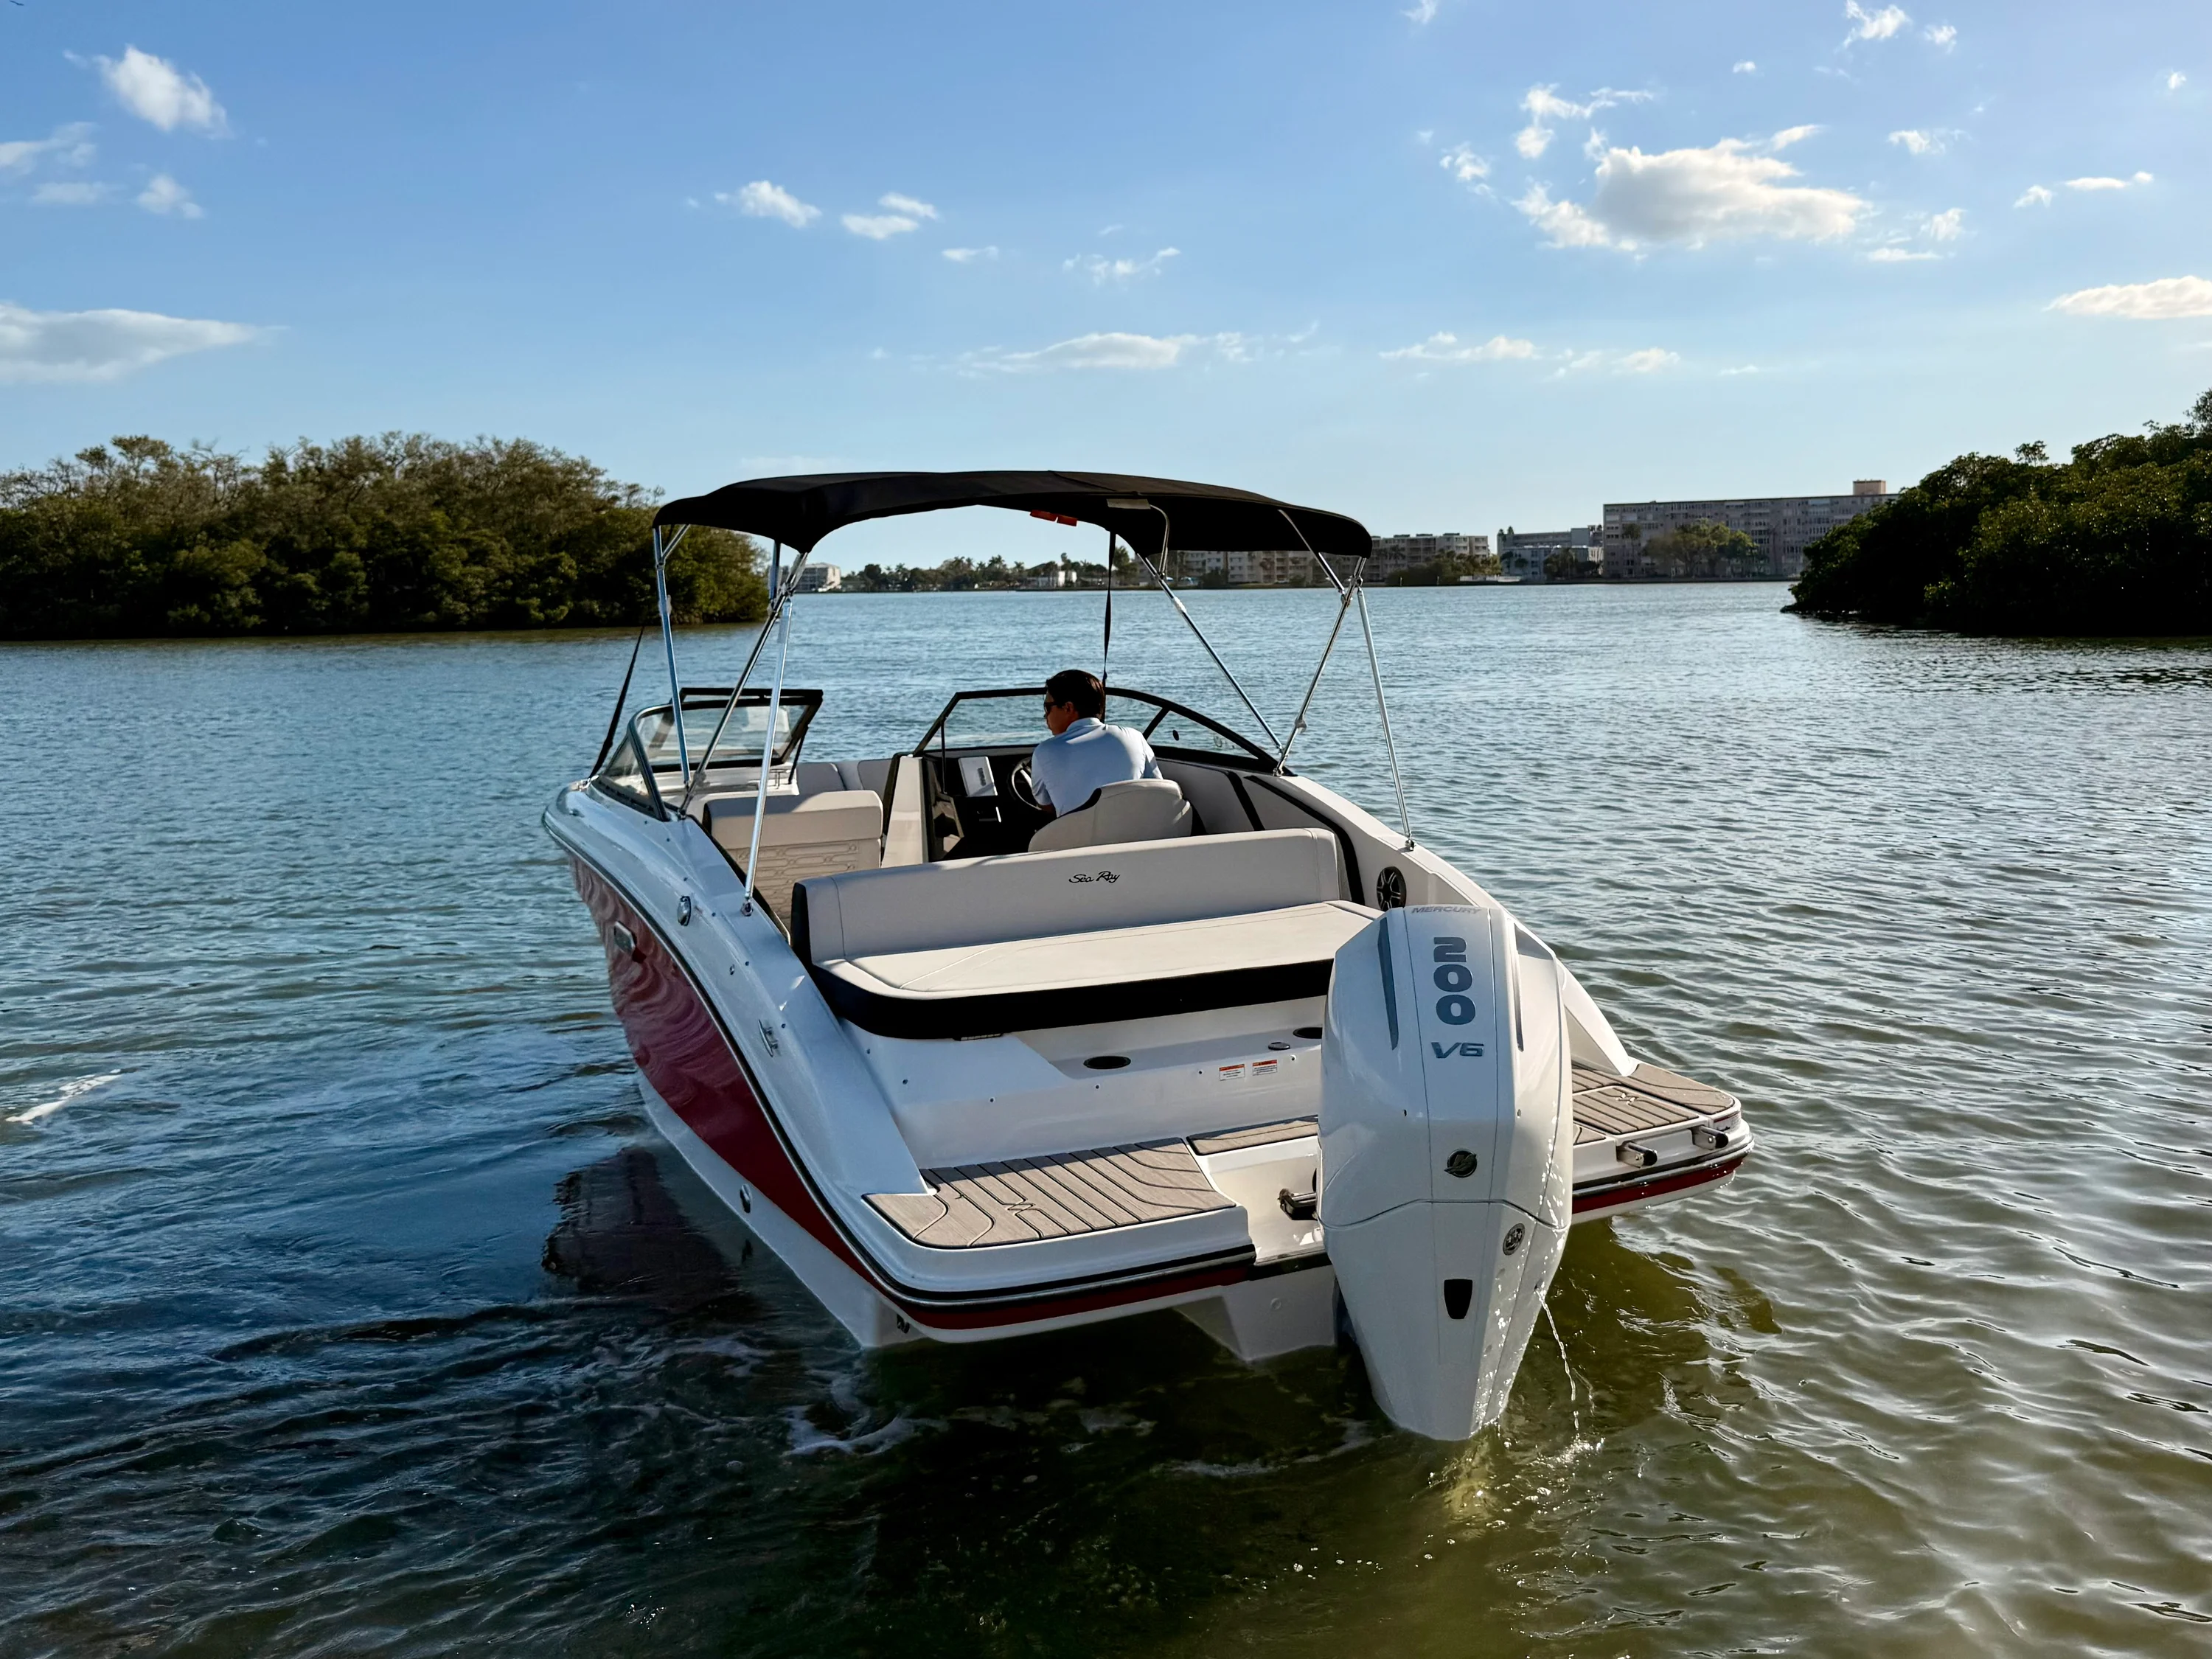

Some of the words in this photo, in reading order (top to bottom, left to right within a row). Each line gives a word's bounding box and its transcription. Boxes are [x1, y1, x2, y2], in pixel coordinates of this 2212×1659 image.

[1069, 874, 1094, 883] Sea
[1096, 871, 1120, 883] Ray
[1411, 906, 1481, 914] MERCURY
[1433, 936, 1475, 1025] 200
[1431, 1042, 1484, 1059] V6
